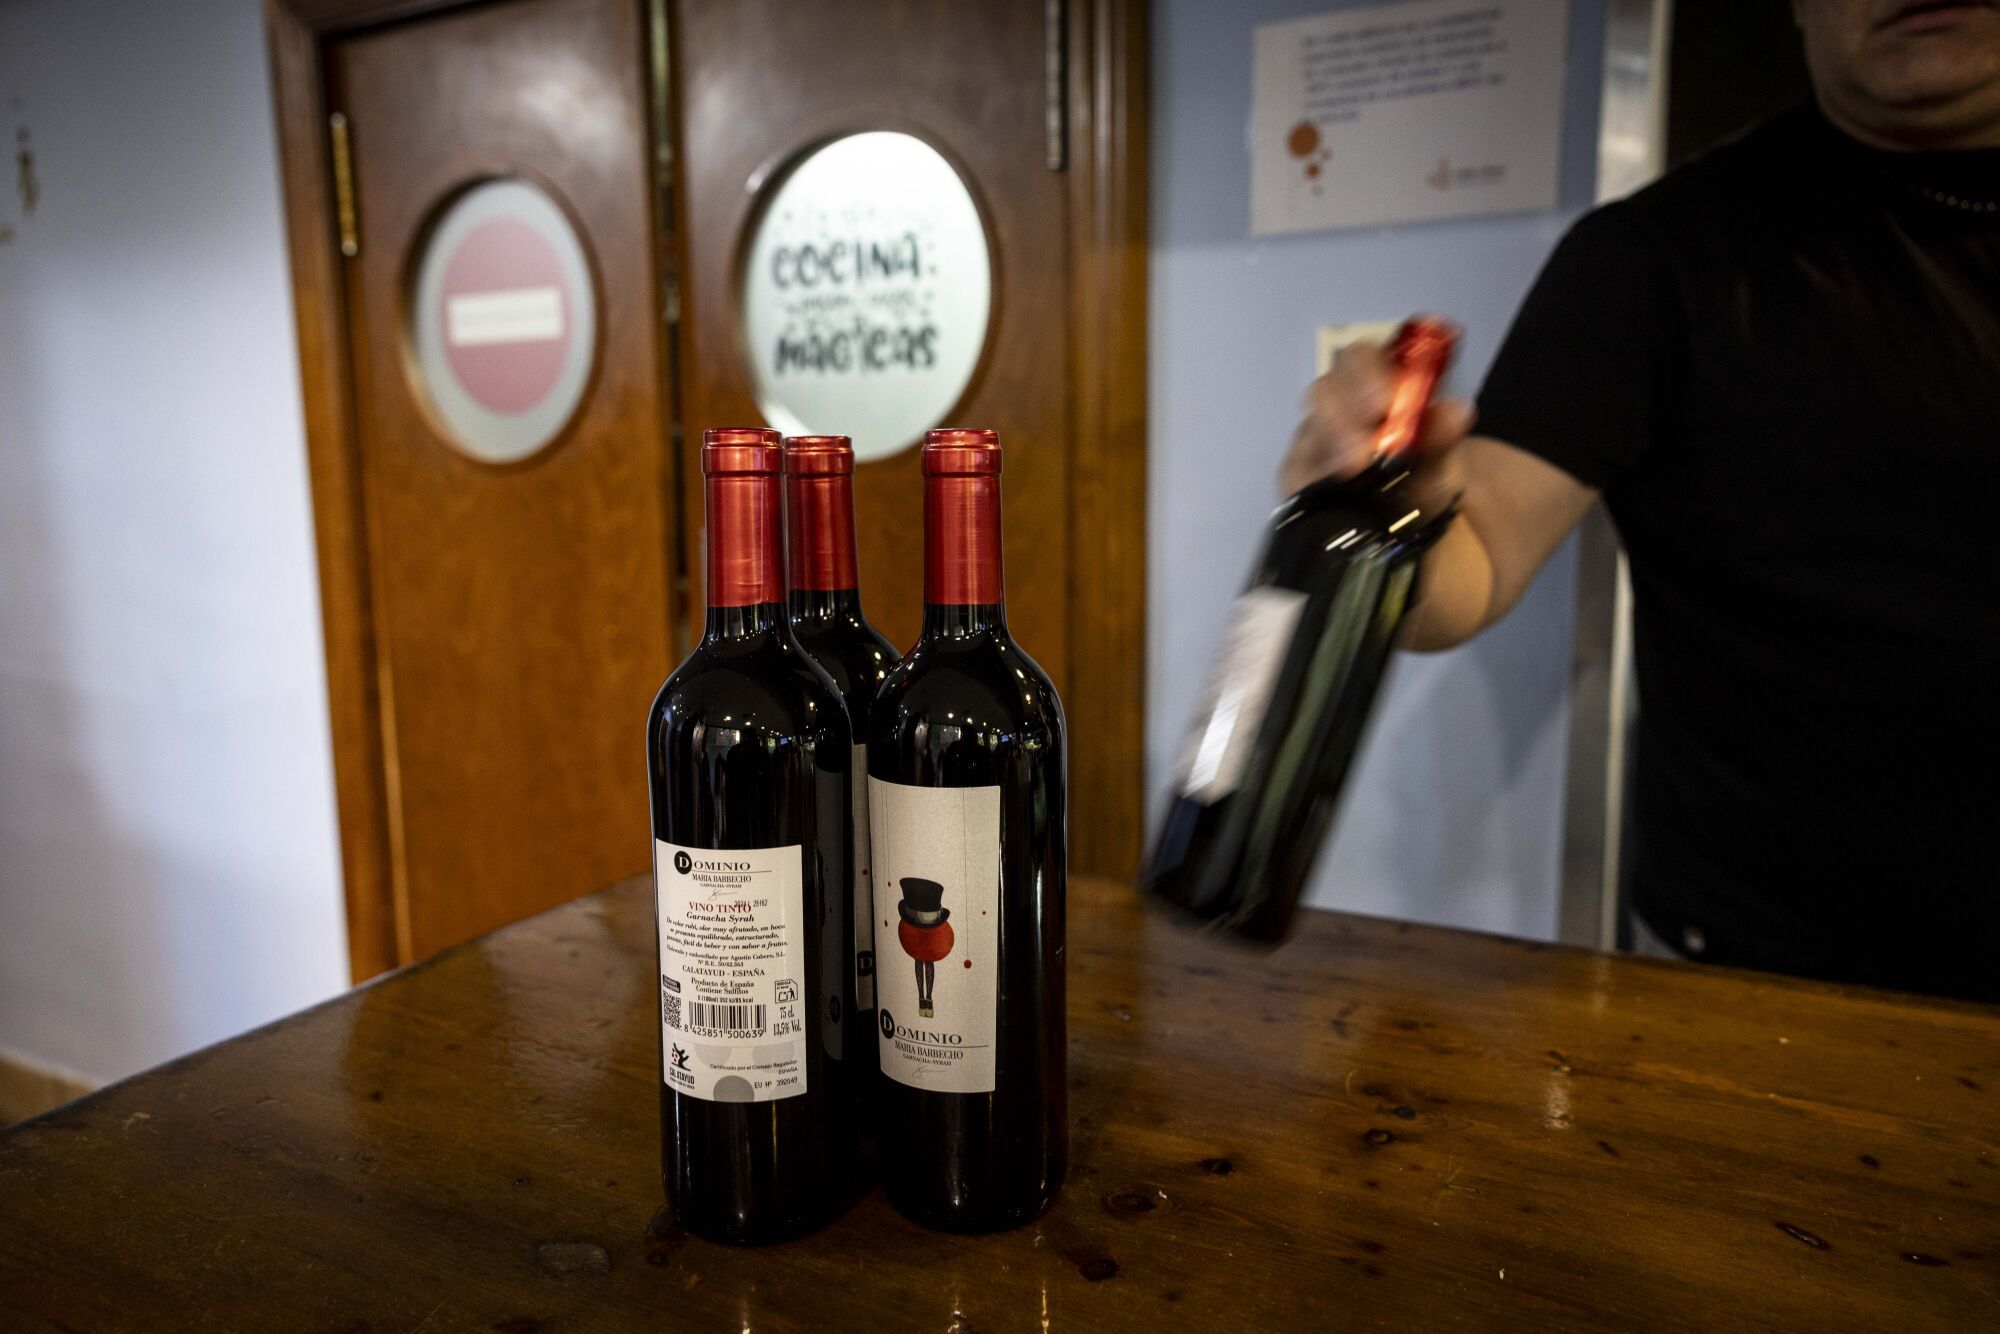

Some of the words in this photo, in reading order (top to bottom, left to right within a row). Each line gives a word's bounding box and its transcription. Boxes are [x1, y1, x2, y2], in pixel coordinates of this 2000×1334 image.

[771, 232, 922, 288] COCINA
[678, 856, 751, 871] DOMINIO
[692, 874, 712, 882] MARIA
[713, 874, 752, 883] BARBECHO
[689, 902, 714, 912] VINO
[716, 904, 752, 914] TINTO
[686, 911, 726, 922] Garnacha
[729, 914, 754, 926] Syrah
[728, 925, 759, 934] afrutado,
[682, 965, 724, 976] CALATAYUD
[732, 968, 765, 976] ESPAÑA
[692, 978, 718, 987] Producto
[730, 980, 754, 989] España
[696, 986, 722, 994] Contiene
[780, 1006, 786, 1019] 75
[684, 1024, 688, 1032] 8
[692, 1026, 723, 1038] 425851
[728, 1030, 764, 1038] 500639
[792, 1019, 802, 1032] Vol.
[883, 1015, 962, 1045] DOMINIO
[895, 1040, 916, 1054] MARIA
[918, 1047, 963, 1060] BARBECHO
[902, 1054, 952, 1066] GARNACHA-SYRAH
